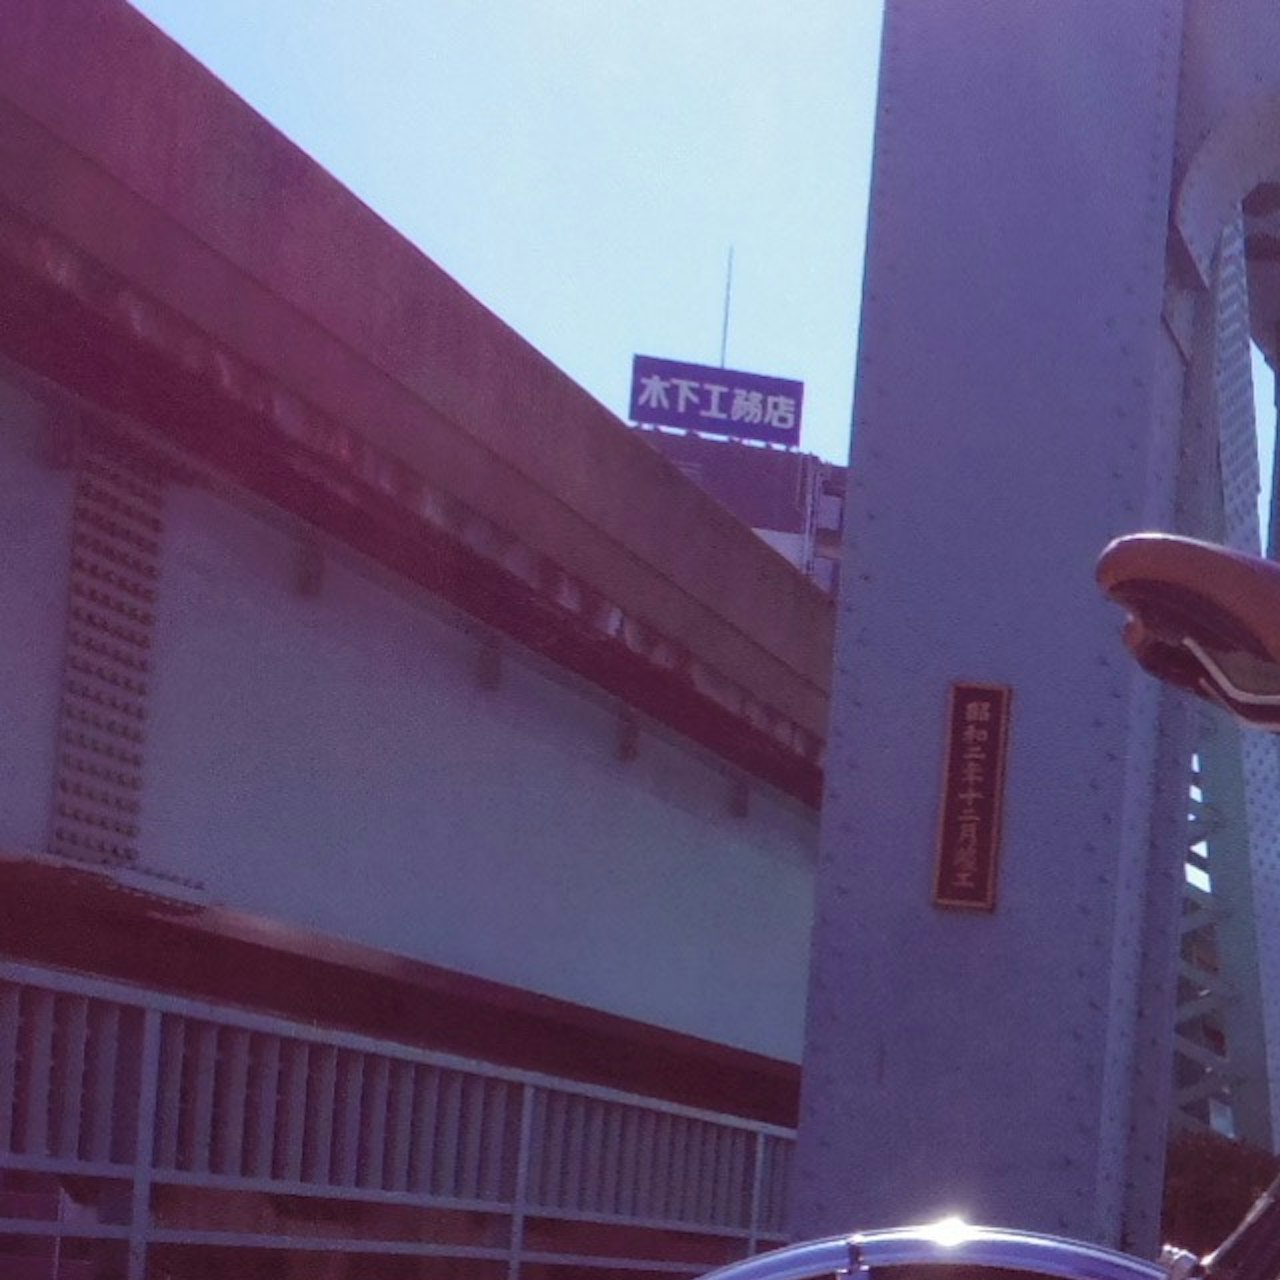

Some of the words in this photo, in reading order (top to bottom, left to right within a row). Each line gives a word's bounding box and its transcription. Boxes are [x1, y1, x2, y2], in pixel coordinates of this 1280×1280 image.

[638, 375, 797, 429] 木下工務店
